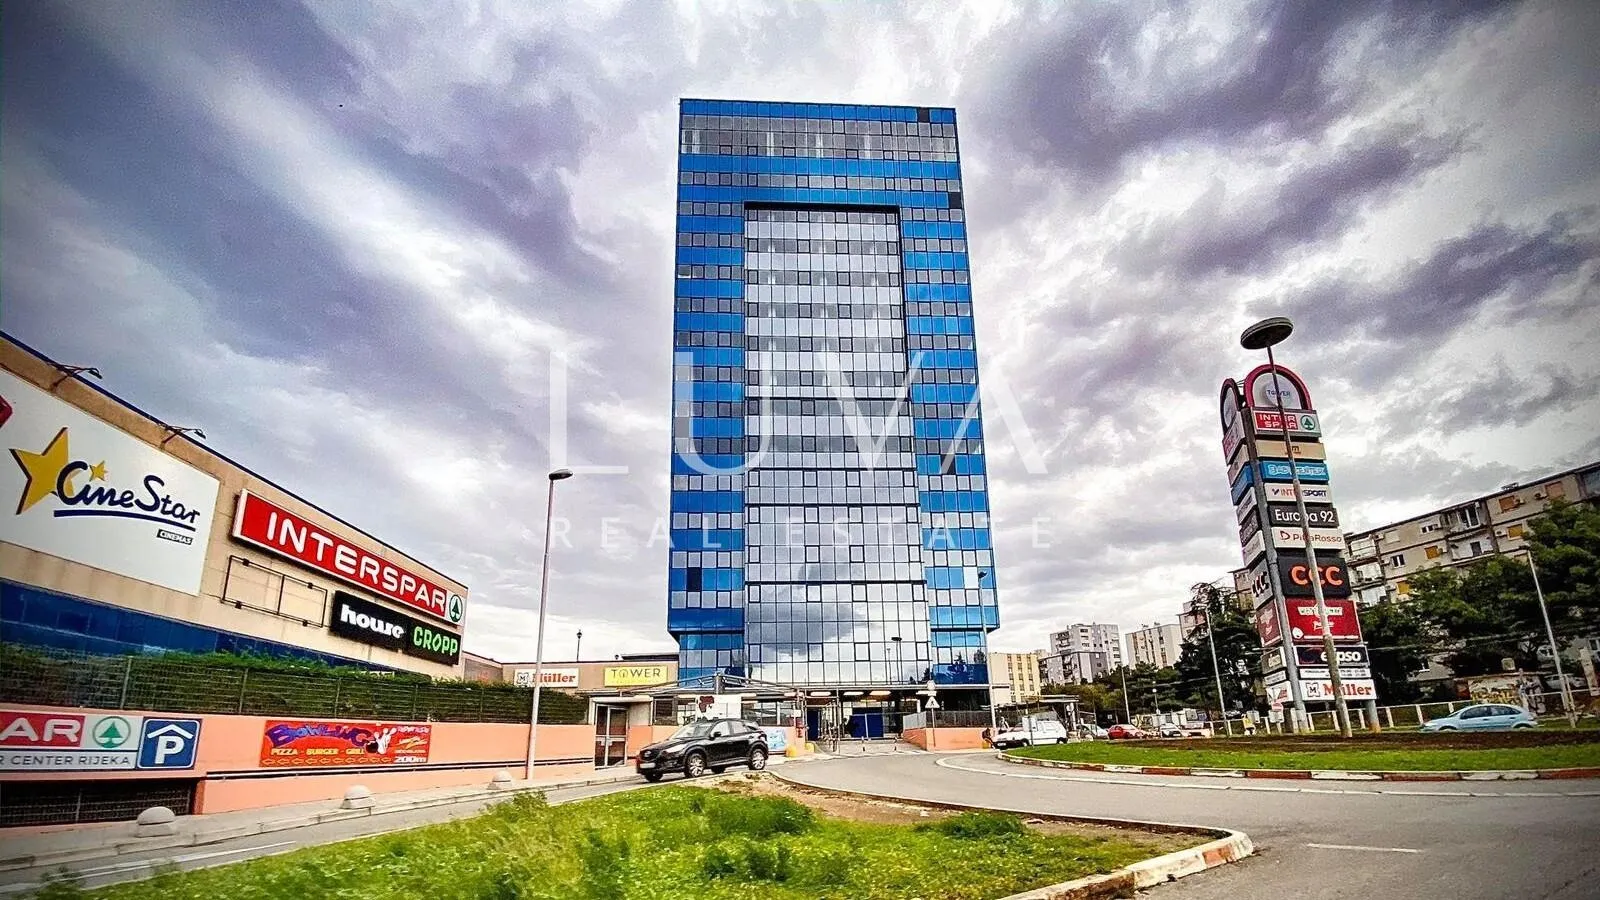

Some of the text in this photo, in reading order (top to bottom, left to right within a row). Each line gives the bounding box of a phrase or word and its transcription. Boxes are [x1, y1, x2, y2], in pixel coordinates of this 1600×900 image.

[57, 461, 200, 523] CineStar
[1281, 488, 1327, 497] INTSPORT
[1320, 511, 1335, 522] 92
[160, 531, 192, 545] CINEMAS
[1293, 533, 1342, 543] PiaRosso
[267, 511, 446, 612] INTERSPAR
[341, 604, 405, 639] house
[413, 627, 458, 656] CROPP
[1321, 648, 1361, 665] epso
[10, 755, 73, 766] CENTER
[78, 755, 131, 765] RIJEKA
